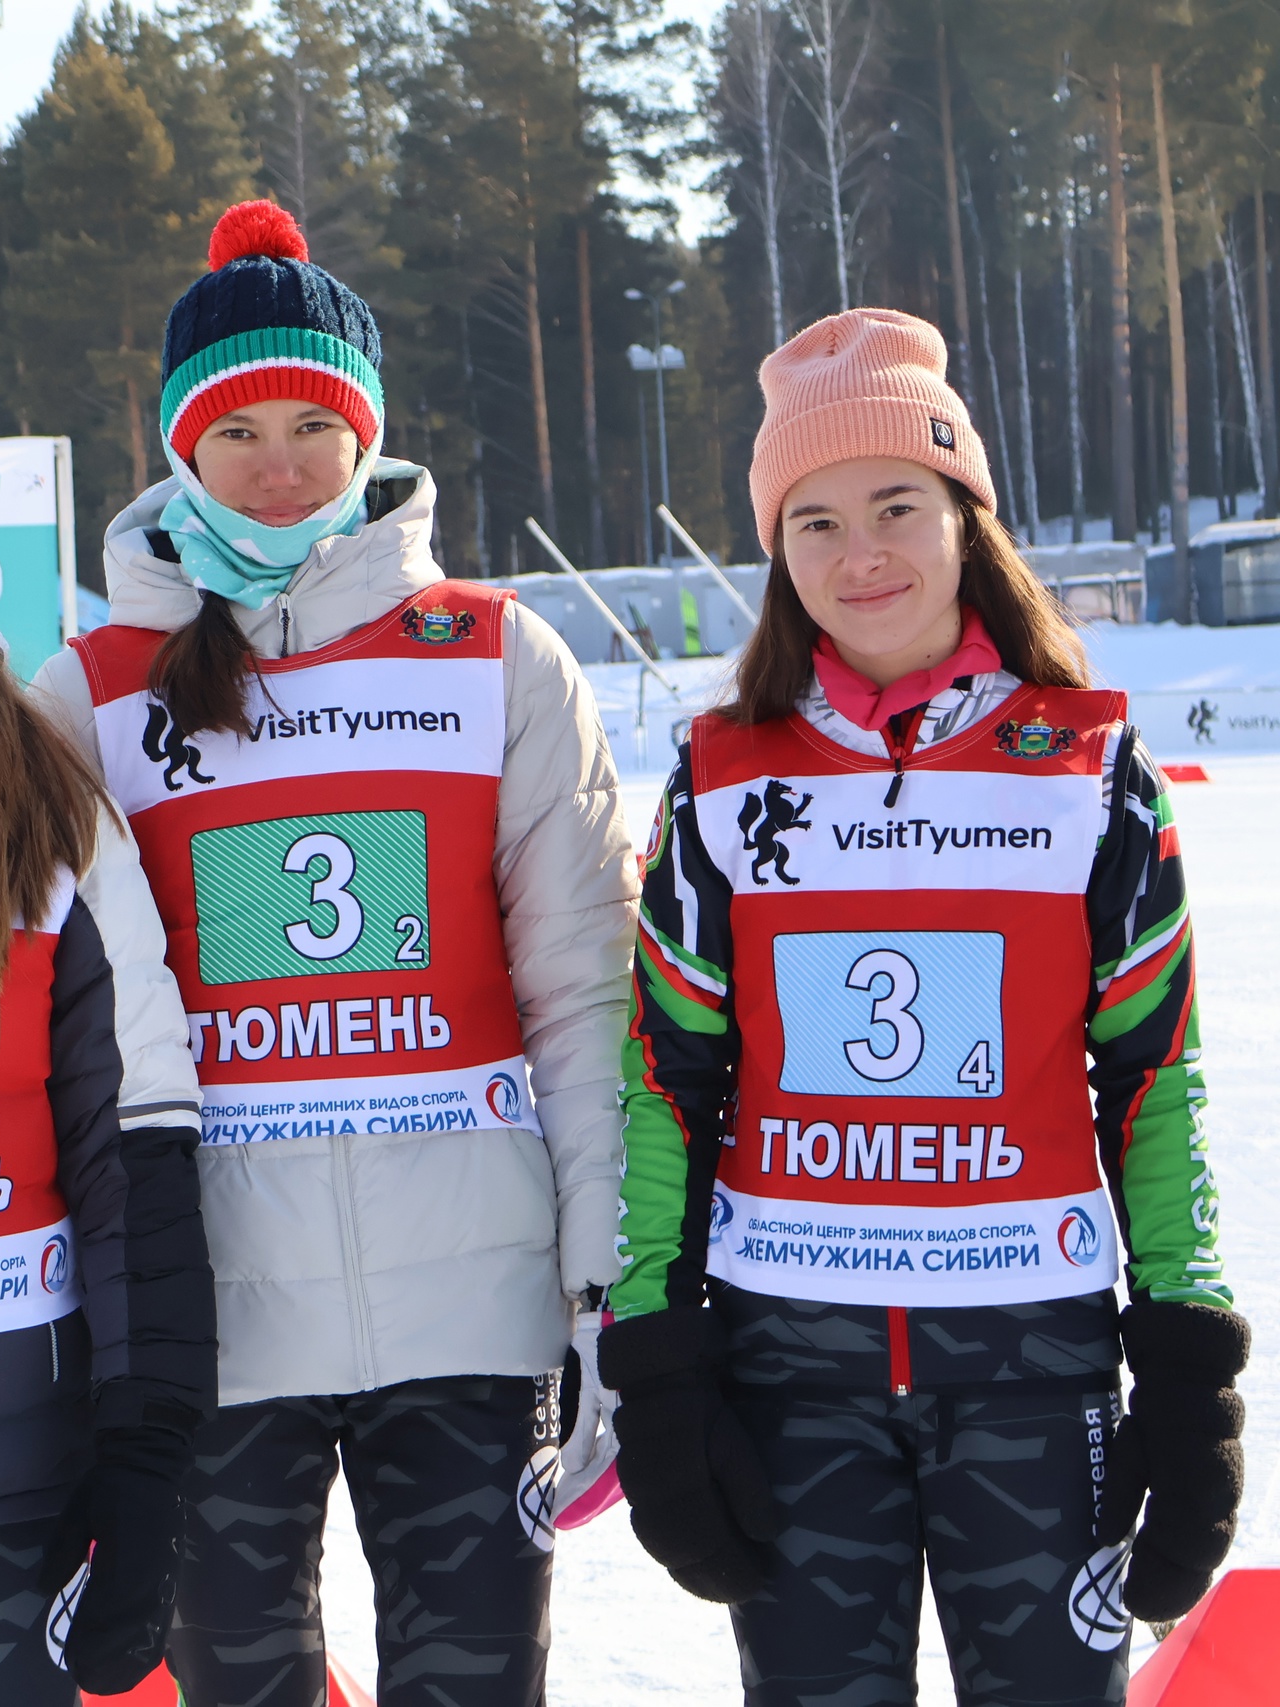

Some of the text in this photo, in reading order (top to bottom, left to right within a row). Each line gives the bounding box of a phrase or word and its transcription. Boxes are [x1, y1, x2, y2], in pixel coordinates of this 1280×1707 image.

[247, 706, 461, 743] VisitTyumen
[832, 819, 1052, 854] VisitTyumen
[281, 831, 425, 962] 3 2
[187, 994, 452, 1063] ТЮМЕНЬ
[842, 948, 995, 1094] 3 4
[199, 1090, 468, 1119] СТНОЙ ЦЕНТР ЗИМНИХ ВИДОВ СПОРТА
[201, 1107, 478, 1143] МЧУЖИНА СИБИРИ
[759, 1116, 1024, 1184] ТЮМЕНЬ
[816, 1224, 857, 1240] ЦЕНТР
[859, 1228, 923, 1242] ЗИМНИХ
[927, 1229, 976, 1243] ВИДОВ
[979, 1224, 1036, 1238] СПОРТА
[735, 1236, 1040, 1271] ЖЕМЧУЖИНА СИБИРИ
[533, 1373, 547, 1440] Сете
